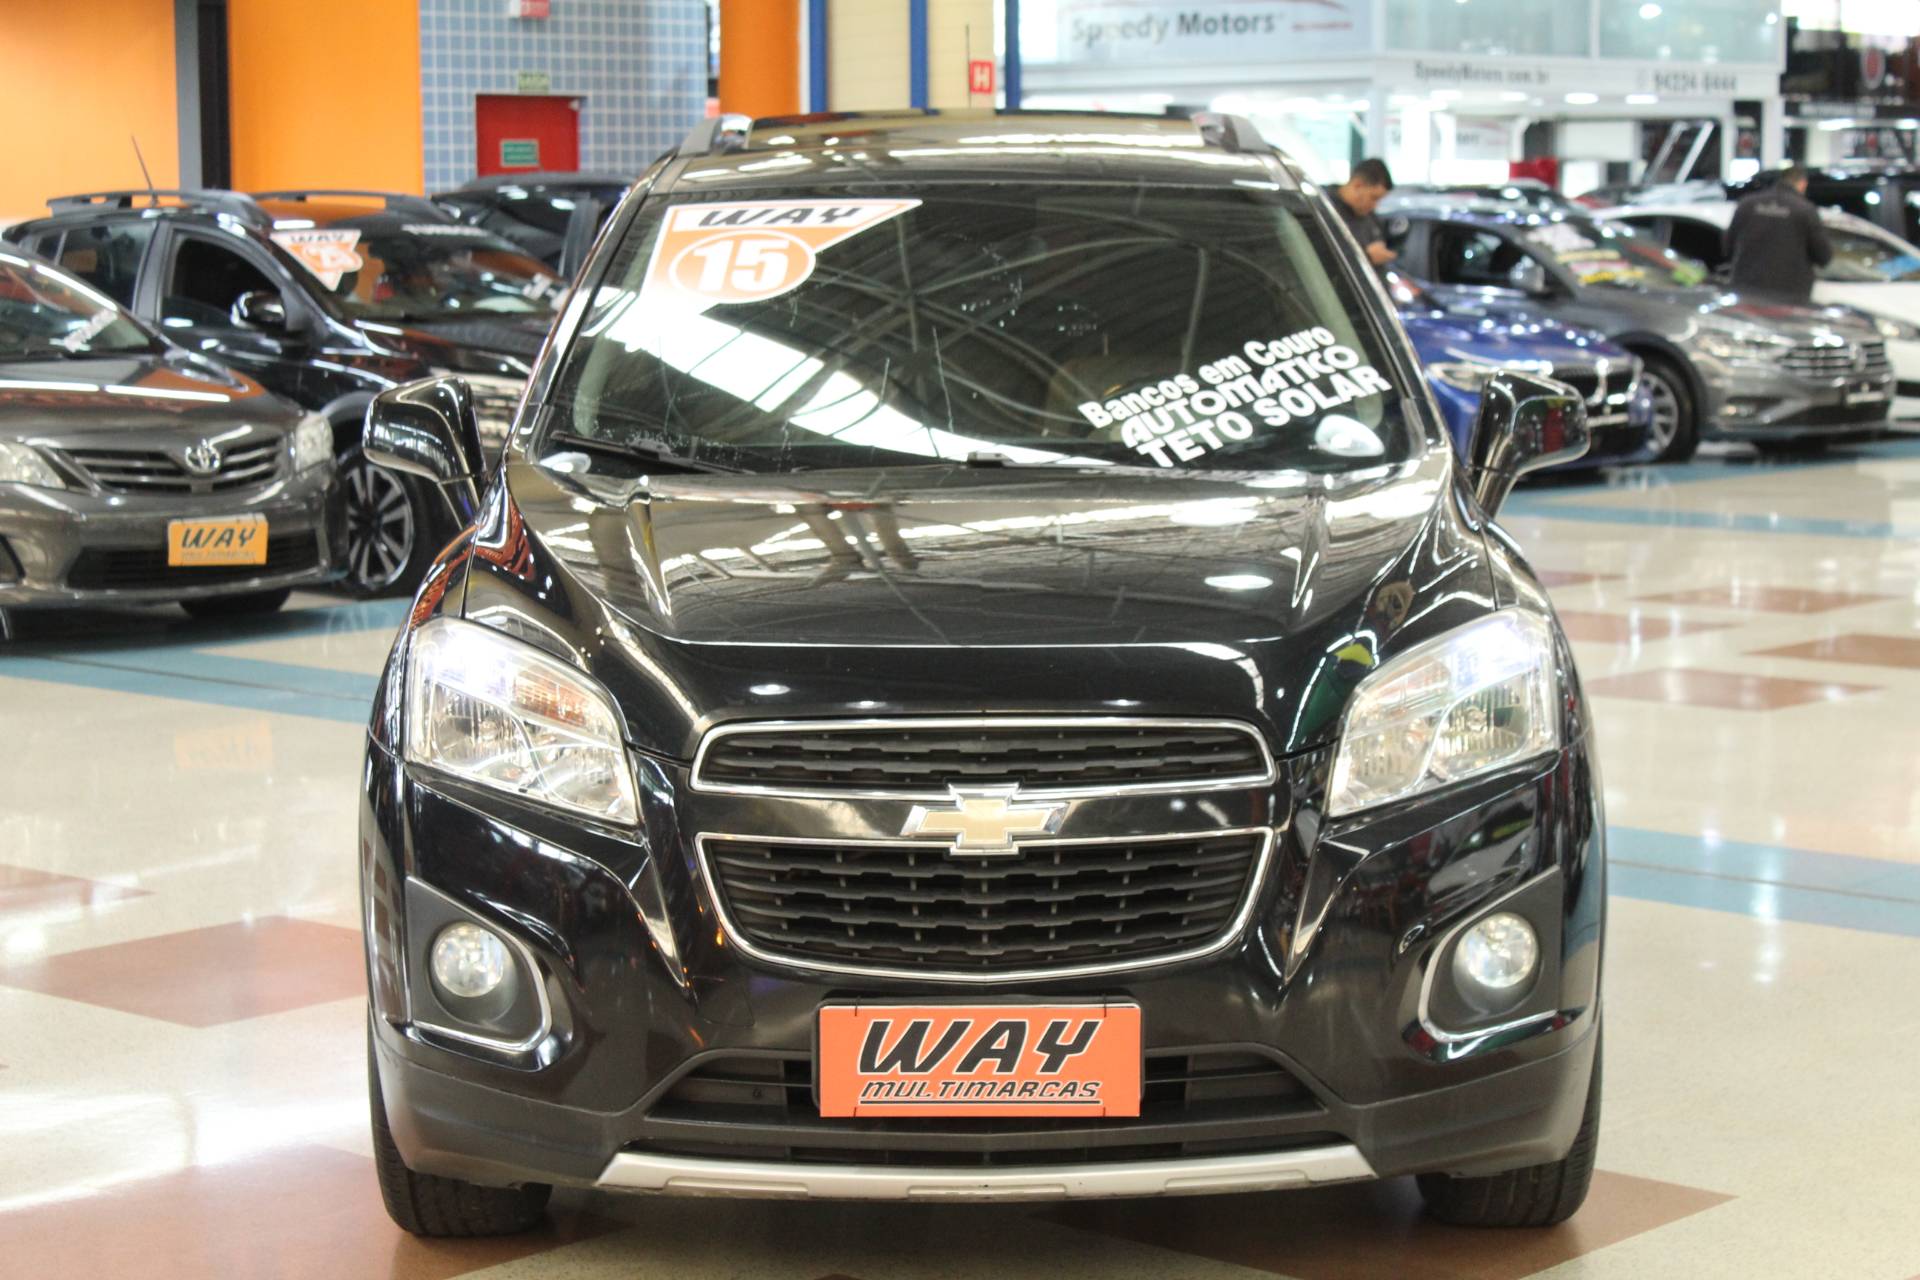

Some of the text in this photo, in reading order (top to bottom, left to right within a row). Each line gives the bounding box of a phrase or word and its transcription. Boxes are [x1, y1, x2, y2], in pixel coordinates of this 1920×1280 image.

[1177, 11, 1276, 36] Motors
[974, 65, 991, 87] H
[698, 207, 862, 227] WAY
[693, 239, 791, 291] 15
[1078, 326, 1335, 428] Bancos em Couro
[1120, 345, 1359, 448] AUTOMATICO
[1136, 366, 1392, 468] TETO SOLAR
[181, 527, 256, 548] WAY
[857, 1019, 1102, 1075] WAY
[859, 1080, 1101, 1099] MULTIMARCAS
